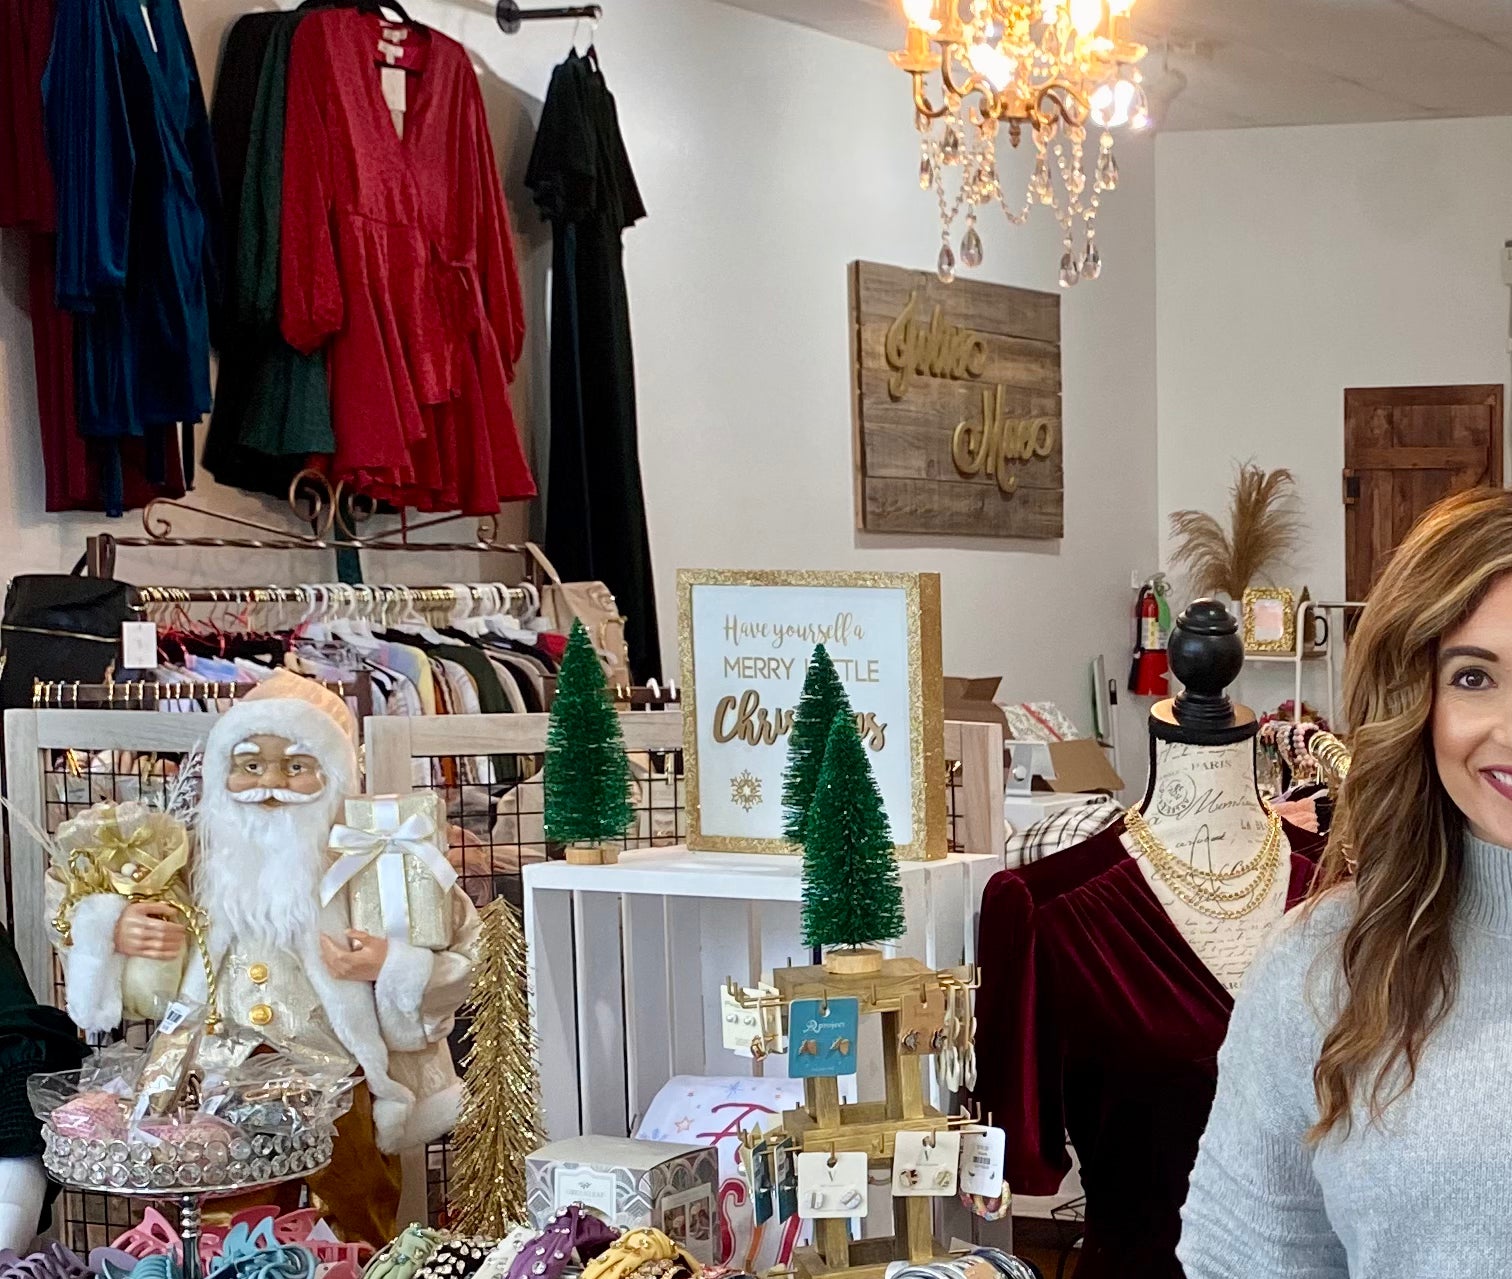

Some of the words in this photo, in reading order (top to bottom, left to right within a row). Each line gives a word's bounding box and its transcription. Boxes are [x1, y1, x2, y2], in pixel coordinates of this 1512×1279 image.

[723, 614, 770, 647] Have
[772, 612, 853, 649] yourself
[853, 623, 866, 641] a
[723, 656, 795, 680] MERRY
